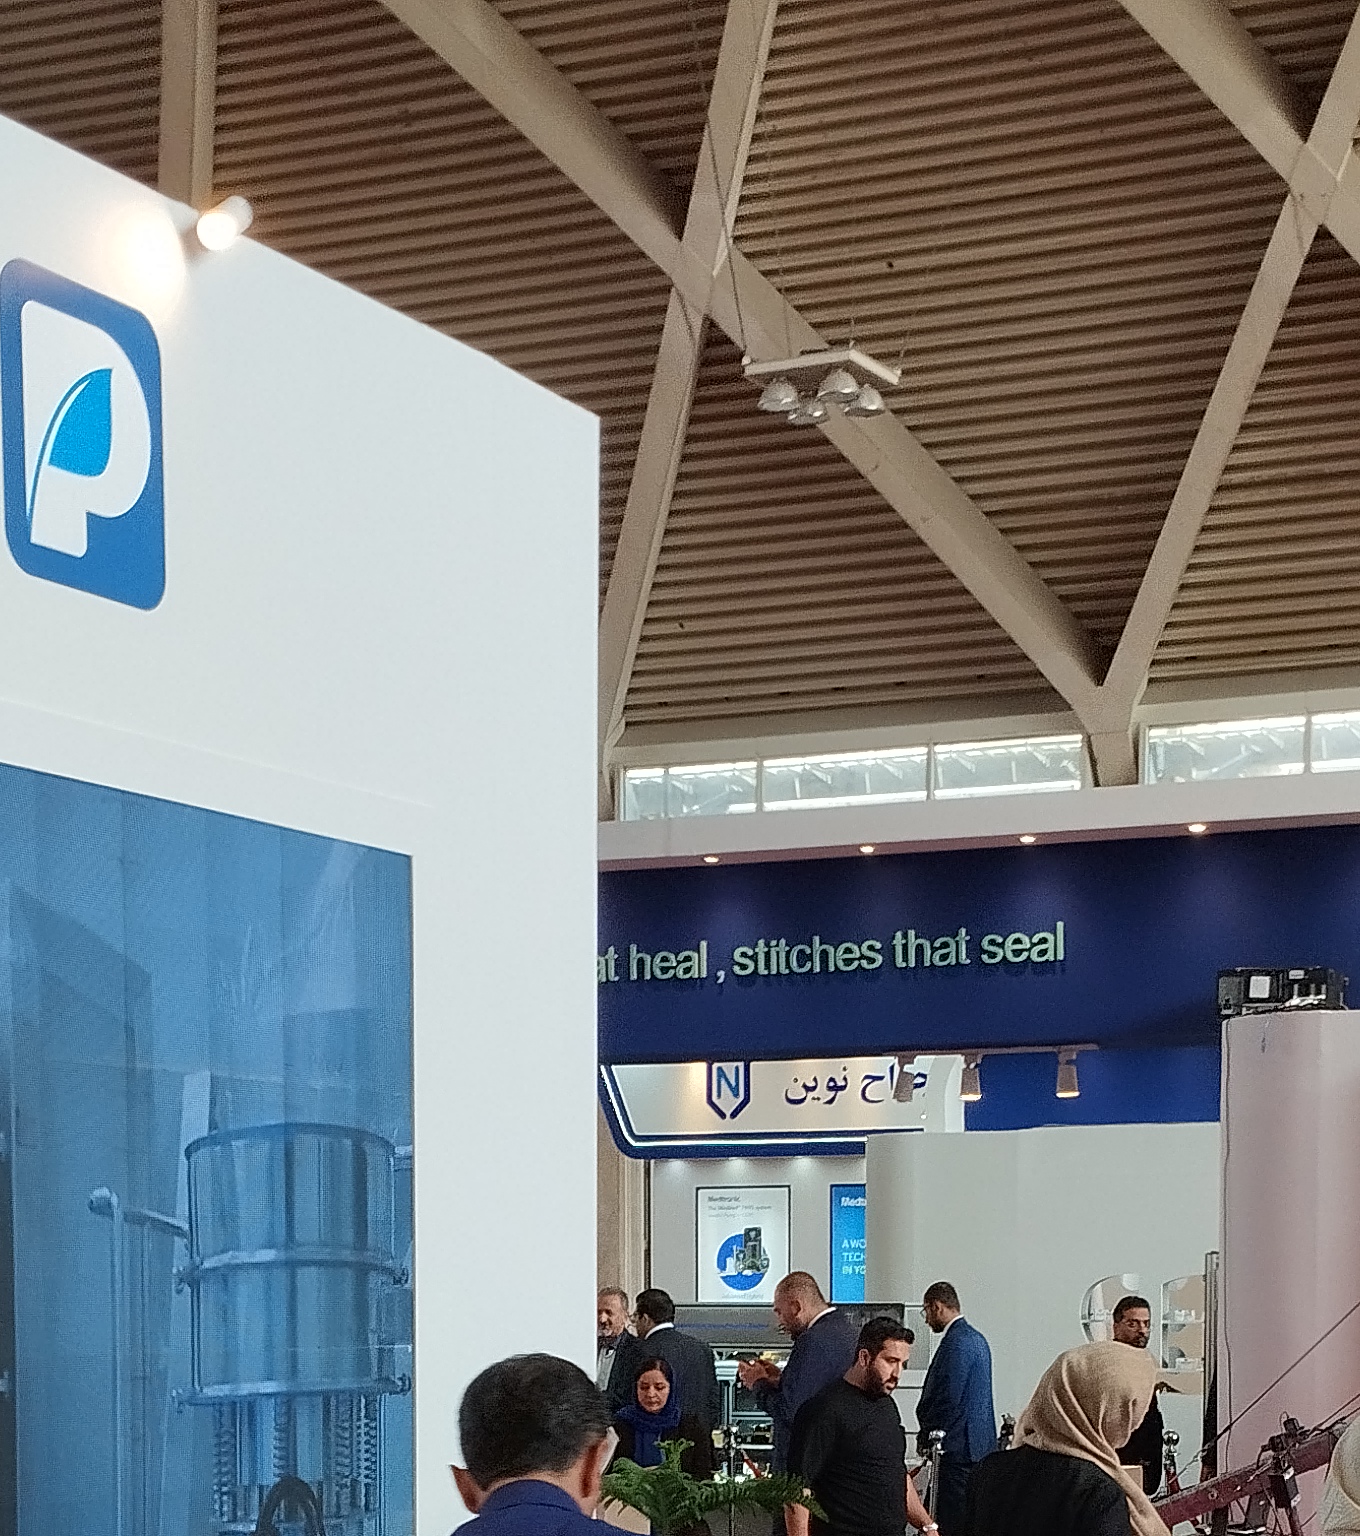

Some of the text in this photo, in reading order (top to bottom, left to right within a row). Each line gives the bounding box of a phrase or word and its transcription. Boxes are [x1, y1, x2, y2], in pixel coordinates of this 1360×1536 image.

[891, 927, 972, 968] that
[980, 920, 1065, 964] seal
[785, 1066, 849, 1105] نوین
